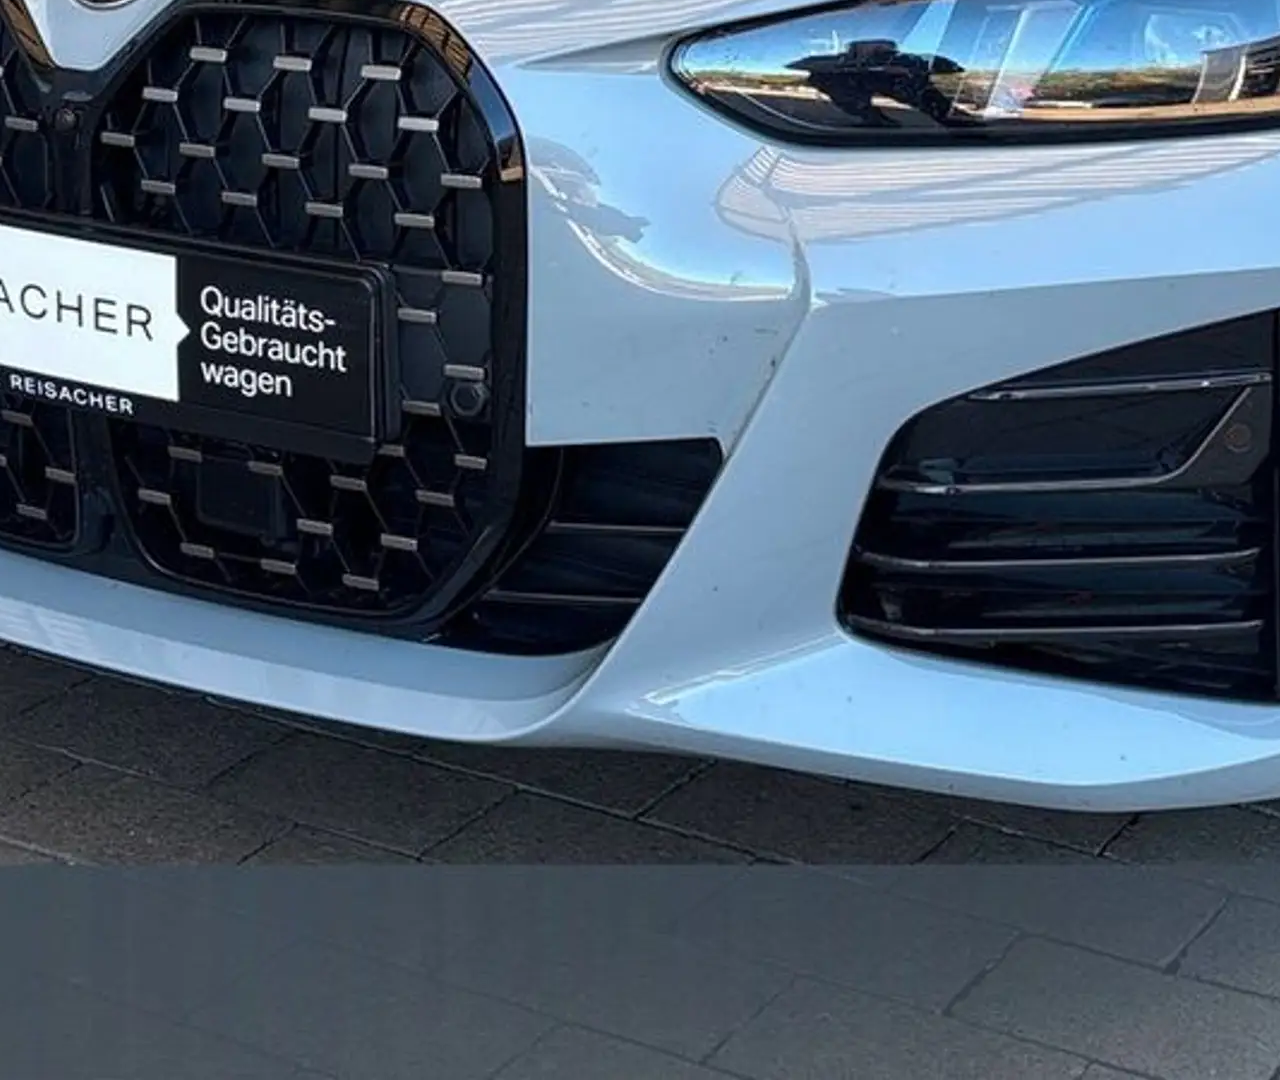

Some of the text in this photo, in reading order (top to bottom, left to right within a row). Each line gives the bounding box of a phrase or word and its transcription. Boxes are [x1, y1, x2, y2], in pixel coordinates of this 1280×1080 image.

[200, 285, 336, 333] Qualitäts-
[200, 321, 347, 373] Gebraucht
[9, 374, 134, 415] REISACHER
[200, 361, 293, 397] wagen
